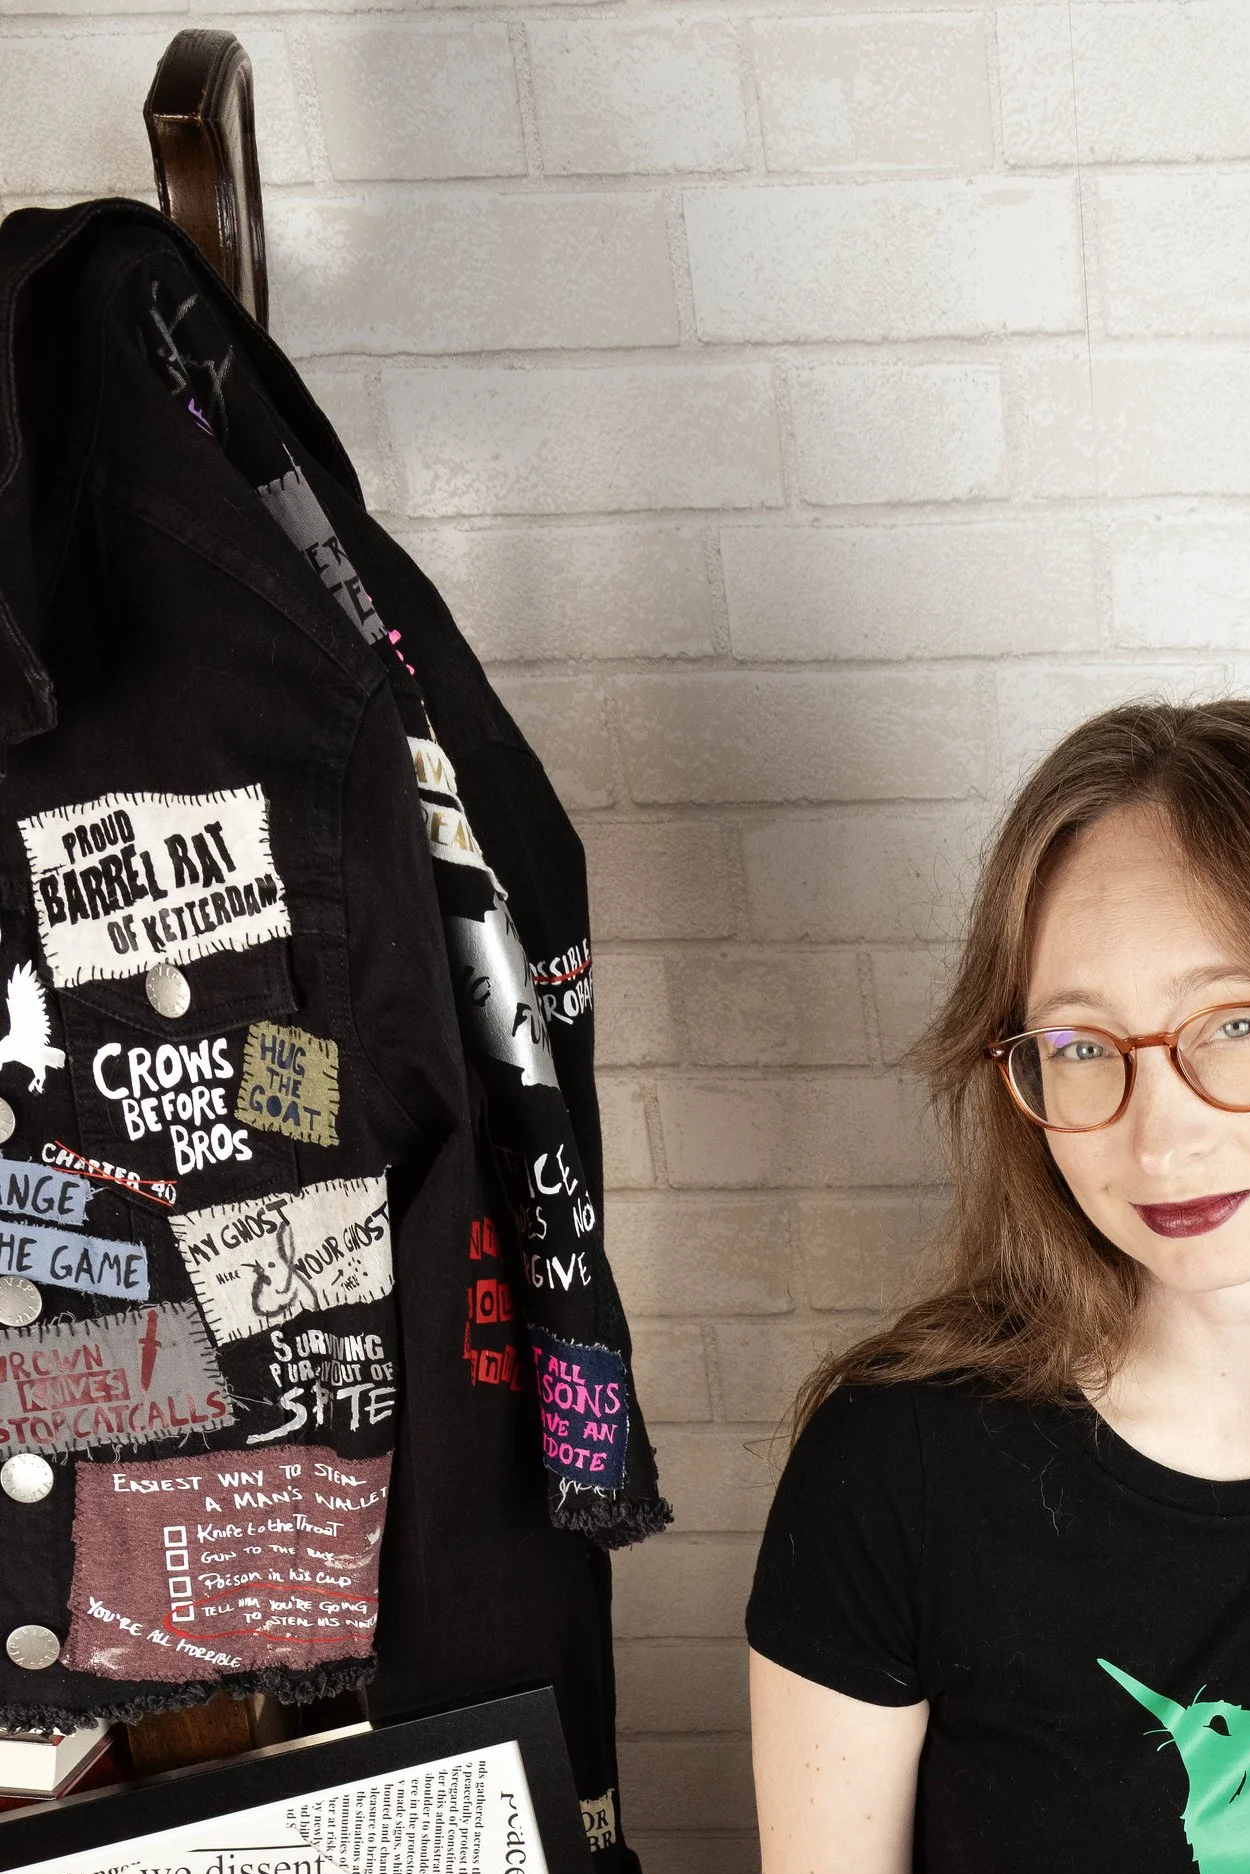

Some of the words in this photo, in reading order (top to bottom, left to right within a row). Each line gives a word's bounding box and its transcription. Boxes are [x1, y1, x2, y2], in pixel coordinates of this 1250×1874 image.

[62, 809, 135, 864] PROUD
[39, 848, 167, 928] BARREL
[164, 821, 237, 889] RAT
[106, 914, 139, 955] OF
[93, 1038, 234, 1100] CROWS
[259, 1033, 307, 1077] HUG
[266, 1067, 301, 1098] THE
[123, 1087, 227, 1141] BEFORE
[249, 1088, 321, 1132] GOAT
[172, 1124, 253, 1175] BROS
[42, 1143, 141, 1191] CHAPTER
[151, 1180, 177, 1205] 40
[188, 1232, 220, 1265] MY
[221, 1200, 290, 1250] GHOST
[294, 1236, 345, 1280] YOUR
[343, 1201, 390, 1252] GHOST
[51, 1245, 143, 1289] GAME
[216, 1270, 241, 1285] HERE
[371, 1362, 394, 1381] OF
[548, 1355, 586, 1386] ALL
[73, 1391, 227, 1438] CATCALLS
[583, 1420, 618, 1444] AN
[113, 1473, 203, 1493] EASIEST
[217, 1470, 264, 1488] WAY
[279, 1464, 301, 1479] TO
[313, 1463, 367, 1487] STEAL
[204, 1496, 223, 1512] A
[234, 1486, 303, 1509] MAN'S
[315, 1486, 388, 1512] WALLET
[197, 1524, 243, 1544] Knife
[201, 1550, 237, 1564] GUN
[243, 1545, 262, 1555] TO
[268, 1545, 296, 1556] THE
[197, 1570, 263, 1591] Poison
[86, 1596, 143, 1637] YOU'RE
[201, 1603, 234, 1618] TELL
[269, 1597, 313, 1614] YOU'RE
[319, 1601, 368, 1614] GOING
[147, 1629, 172, 1648] ALL
[176, 1638, 243, 1668] HORRIBLE
[460, 1770, 473, 1824] peacefully
[475, 1782, 486, 1828] gathered
